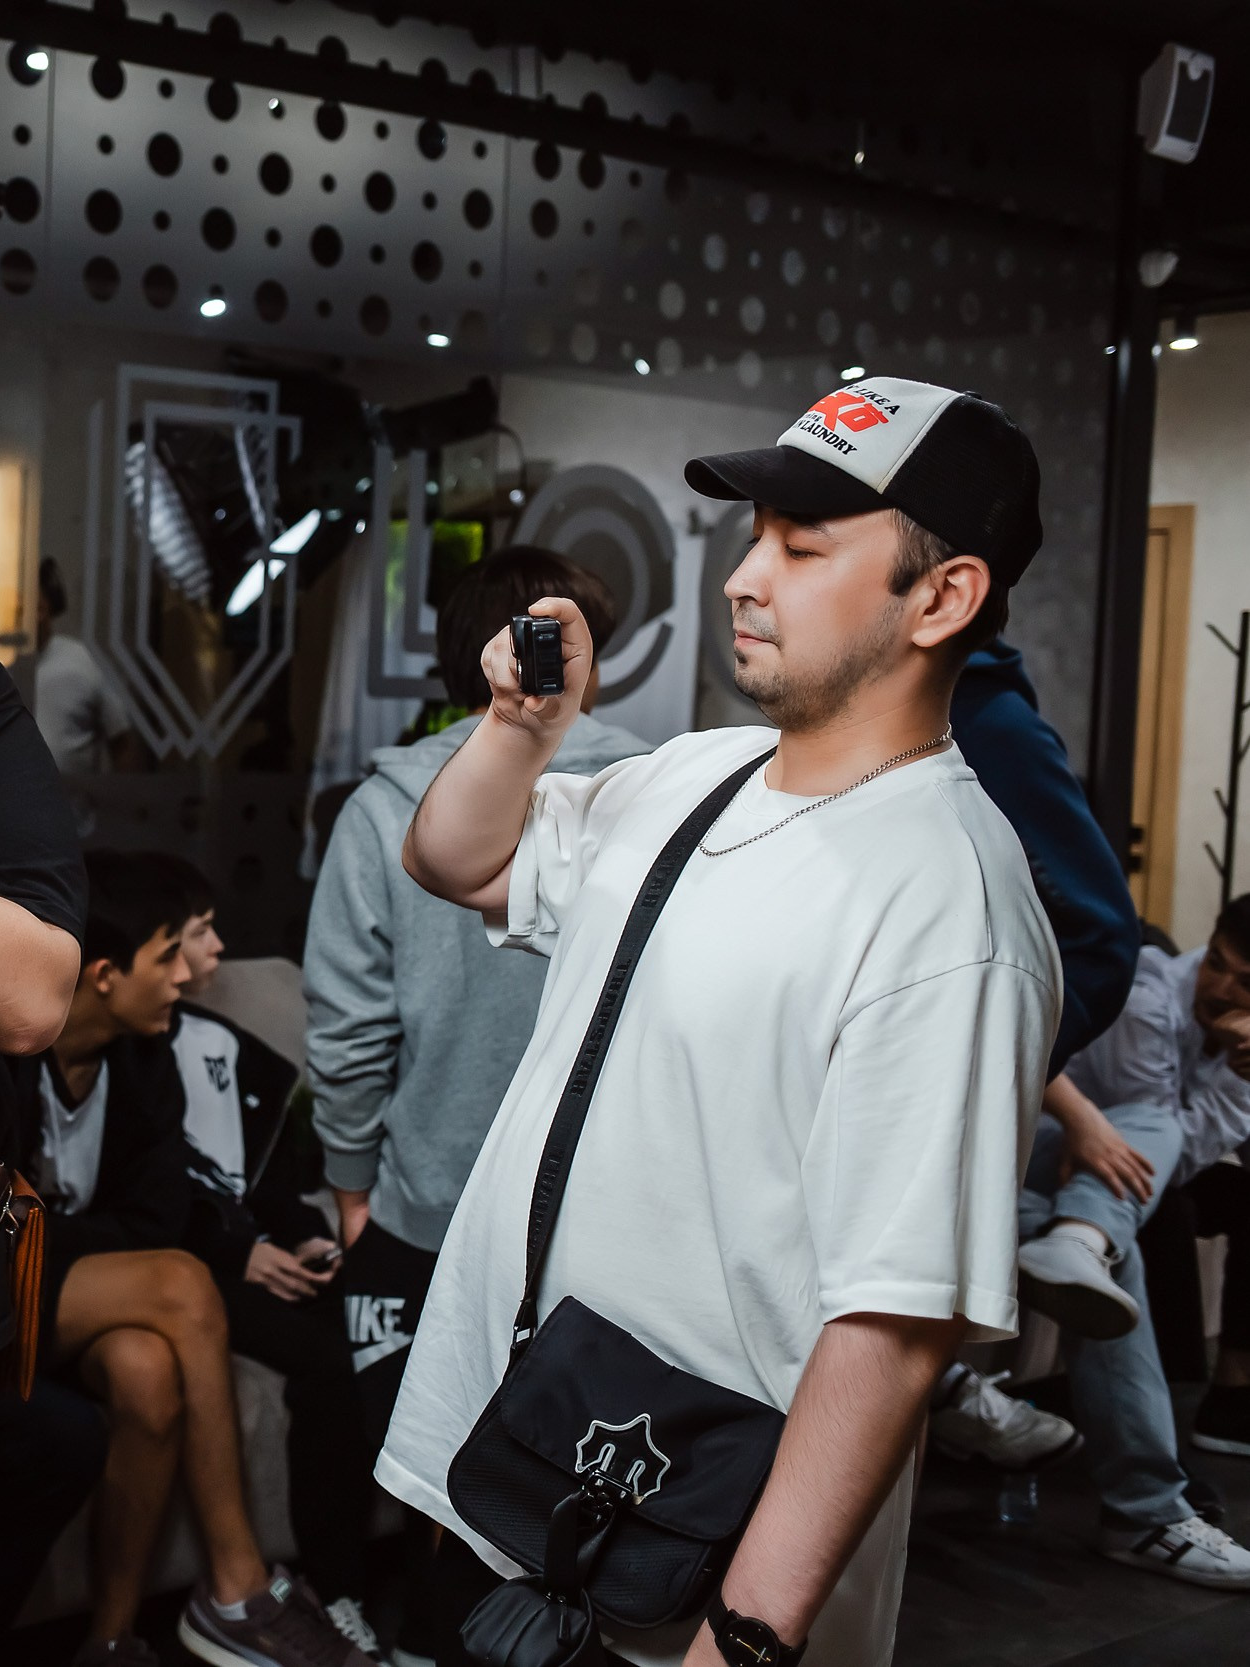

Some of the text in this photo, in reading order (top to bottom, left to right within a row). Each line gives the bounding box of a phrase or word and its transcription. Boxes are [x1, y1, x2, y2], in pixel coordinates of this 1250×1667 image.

[853, 388, 891, 405] LIKE
[884, 405, 901, 415] A
[800, 420, 857, 455] LAUNDRY
